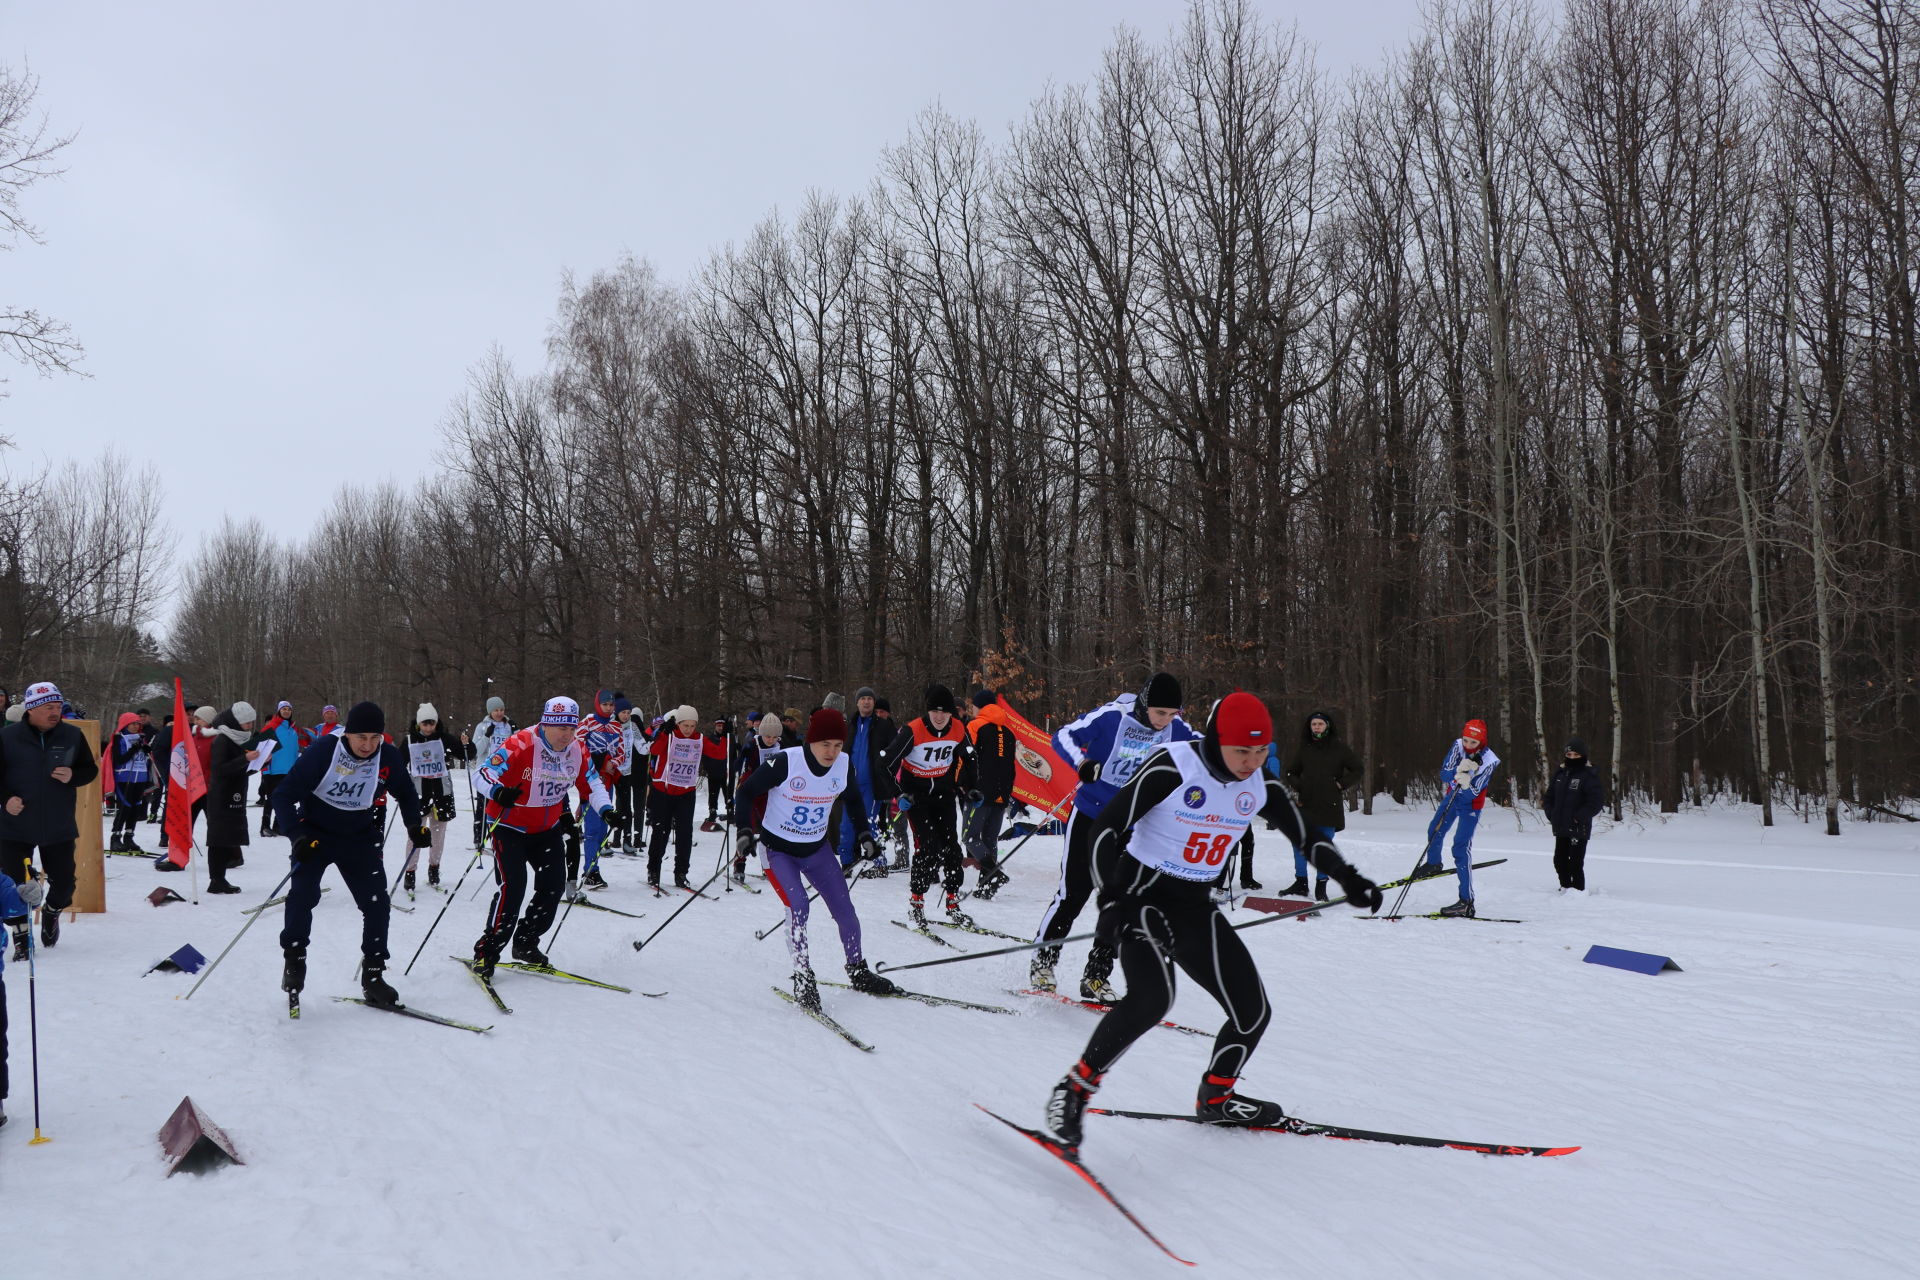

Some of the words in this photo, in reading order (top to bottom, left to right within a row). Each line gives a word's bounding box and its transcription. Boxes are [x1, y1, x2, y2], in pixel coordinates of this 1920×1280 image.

[923, 746, 952, 762] 716
[416, 762, 443, 775] 17790
[669, 762, 696, 776] 12761
[326, 781, 366, 798] 2941
[791, 805, 825, 825] 83
[1183, 831, 1232, 866] 58
